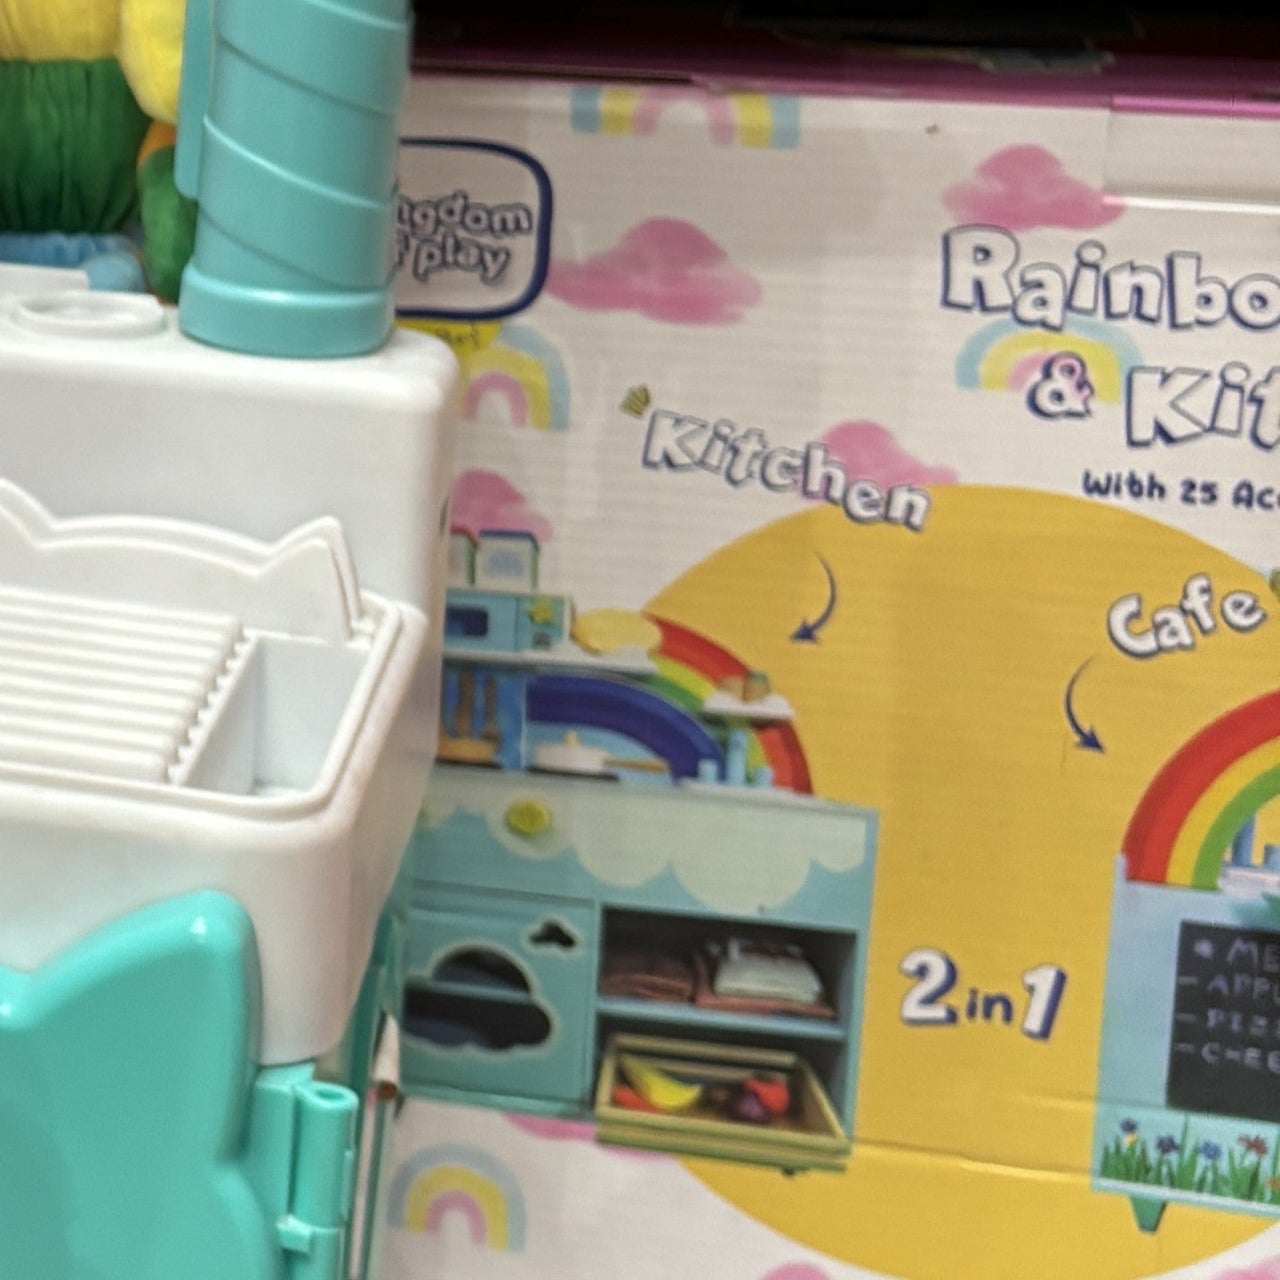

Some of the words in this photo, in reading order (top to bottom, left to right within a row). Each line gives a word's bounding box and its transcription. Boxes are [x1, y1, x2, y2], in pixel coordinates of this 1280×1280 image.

[411, 232, 512, 287] play
[940, 222, 1280, 332] Rainbo
[1026, 349, 1094, 418] &
[642, 408, 932, 533] Kitchen
[1083, 469, 1167, 500] With
[1180, 477, 1219, 505] 25
[1107, 572, 1268, 660] Cafe
[899, 946, 958, 1027] 2
[966, 986, 1014, 1025] in
[1022, 963, 1067, 1041] 1
